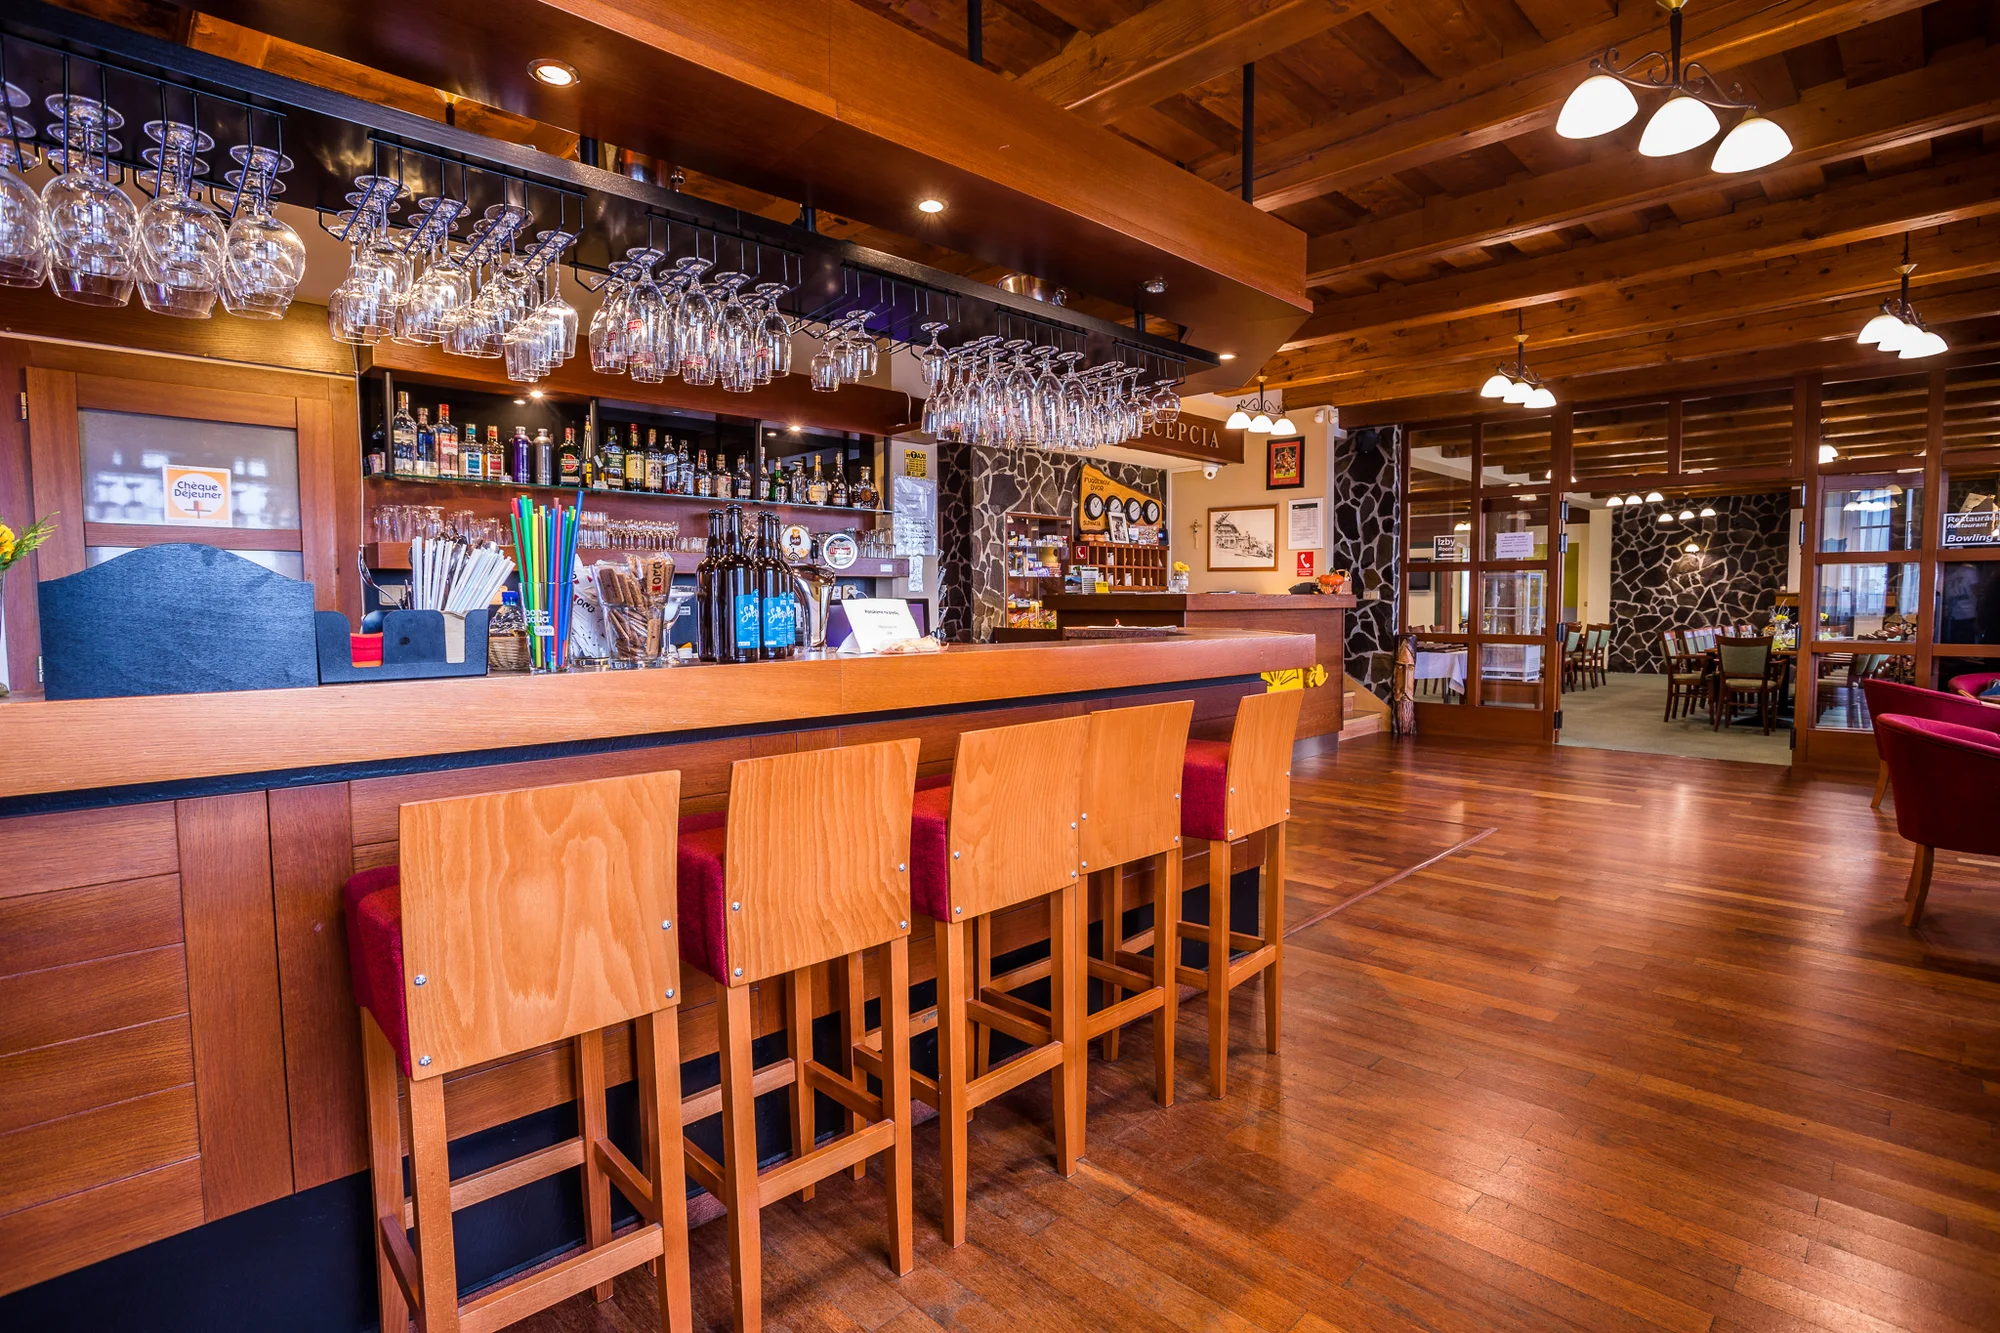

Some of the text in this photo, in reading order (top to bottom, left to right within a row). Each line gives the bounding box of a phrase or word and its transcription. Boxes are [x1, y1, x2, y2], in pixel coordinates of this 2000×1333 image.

[1141, 419, 1220, 448] CEPCIA
[177, 481, 218, 491] Chèque
[174, 488, 222, 499] Déjeuner
[1438, 538, 1455, 547] Izby
[1947, 534, 1993, 542] Bowling
